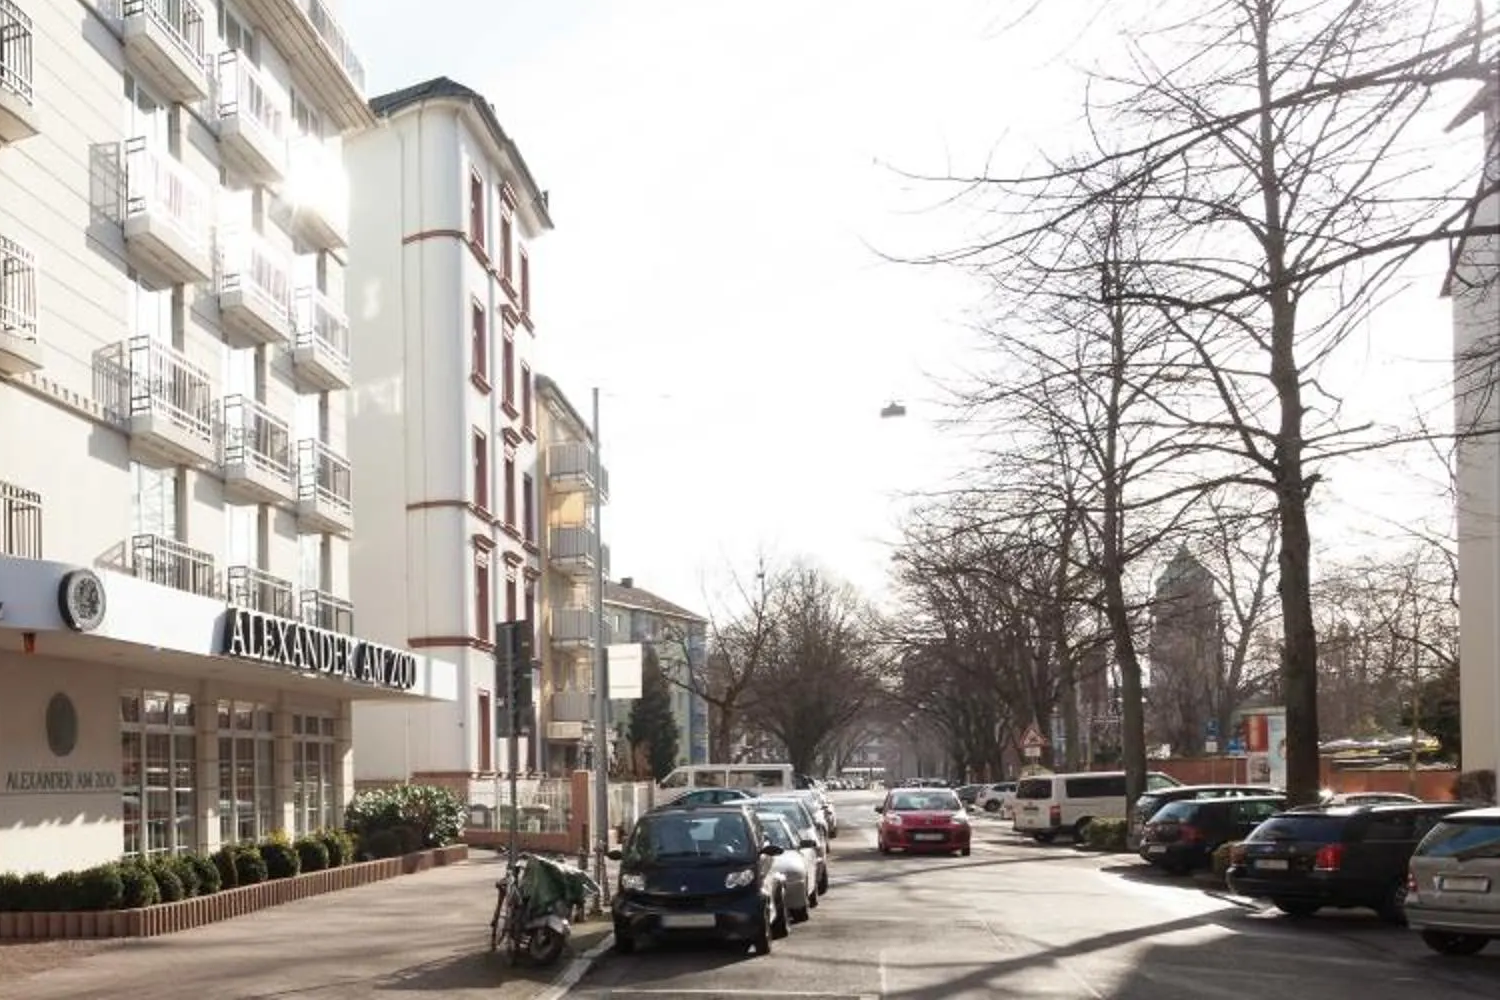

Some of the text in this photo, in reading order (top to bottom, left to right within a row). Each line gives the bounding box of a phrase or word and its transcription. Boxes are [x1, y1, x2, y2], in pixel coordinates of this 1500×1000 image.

[229, 608, 417, 690] ALEXANDER AM ZOO
[6, 771, 117, 790] ALEXANDER AM ZOO
